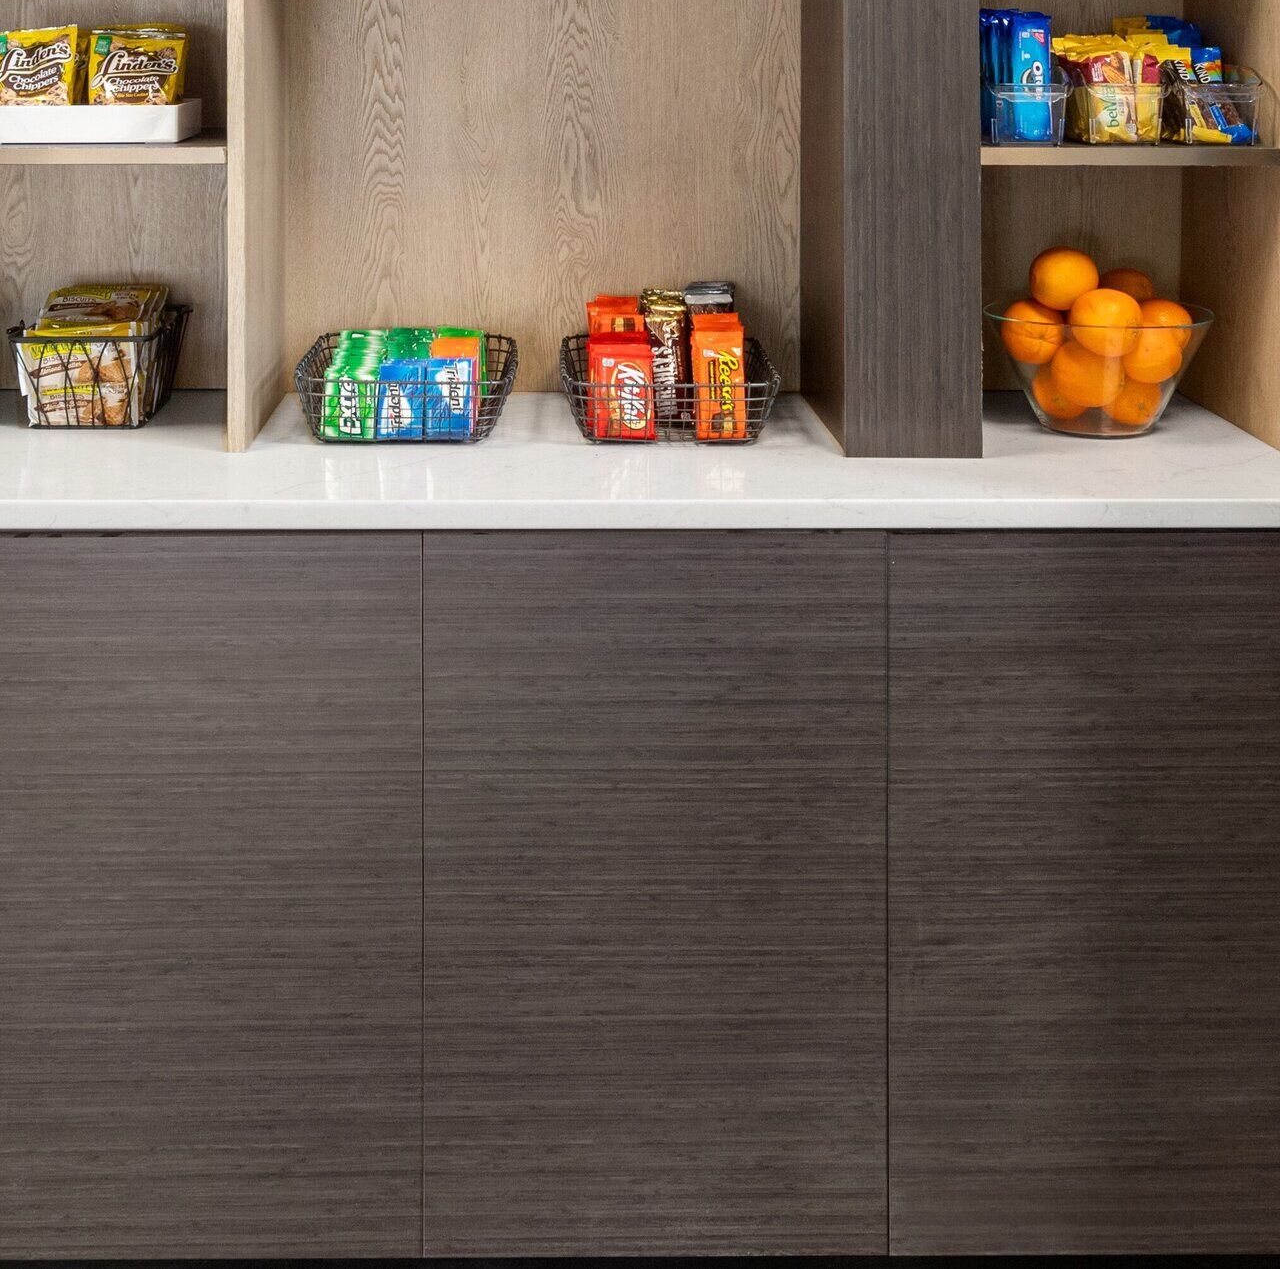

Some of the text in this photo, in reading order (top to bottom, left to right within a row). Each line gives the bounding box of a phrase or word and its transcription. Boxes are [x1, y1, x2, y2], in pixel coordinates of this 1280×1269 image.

[8, 67, 58, 83] Chocolate
[91, 49, 179, 89] Linden's
[1194, 62, 1210, 84] KIND
[13, 76, 59, 91] Chippers
[107, 76, 159, 86] Chocolate
[113, 83, 158, 93] Chippers
[444, 363, 463, 414] Trident
[617, 363, 645, 393] Kit
[717, 350, 740, 412] Reese's
